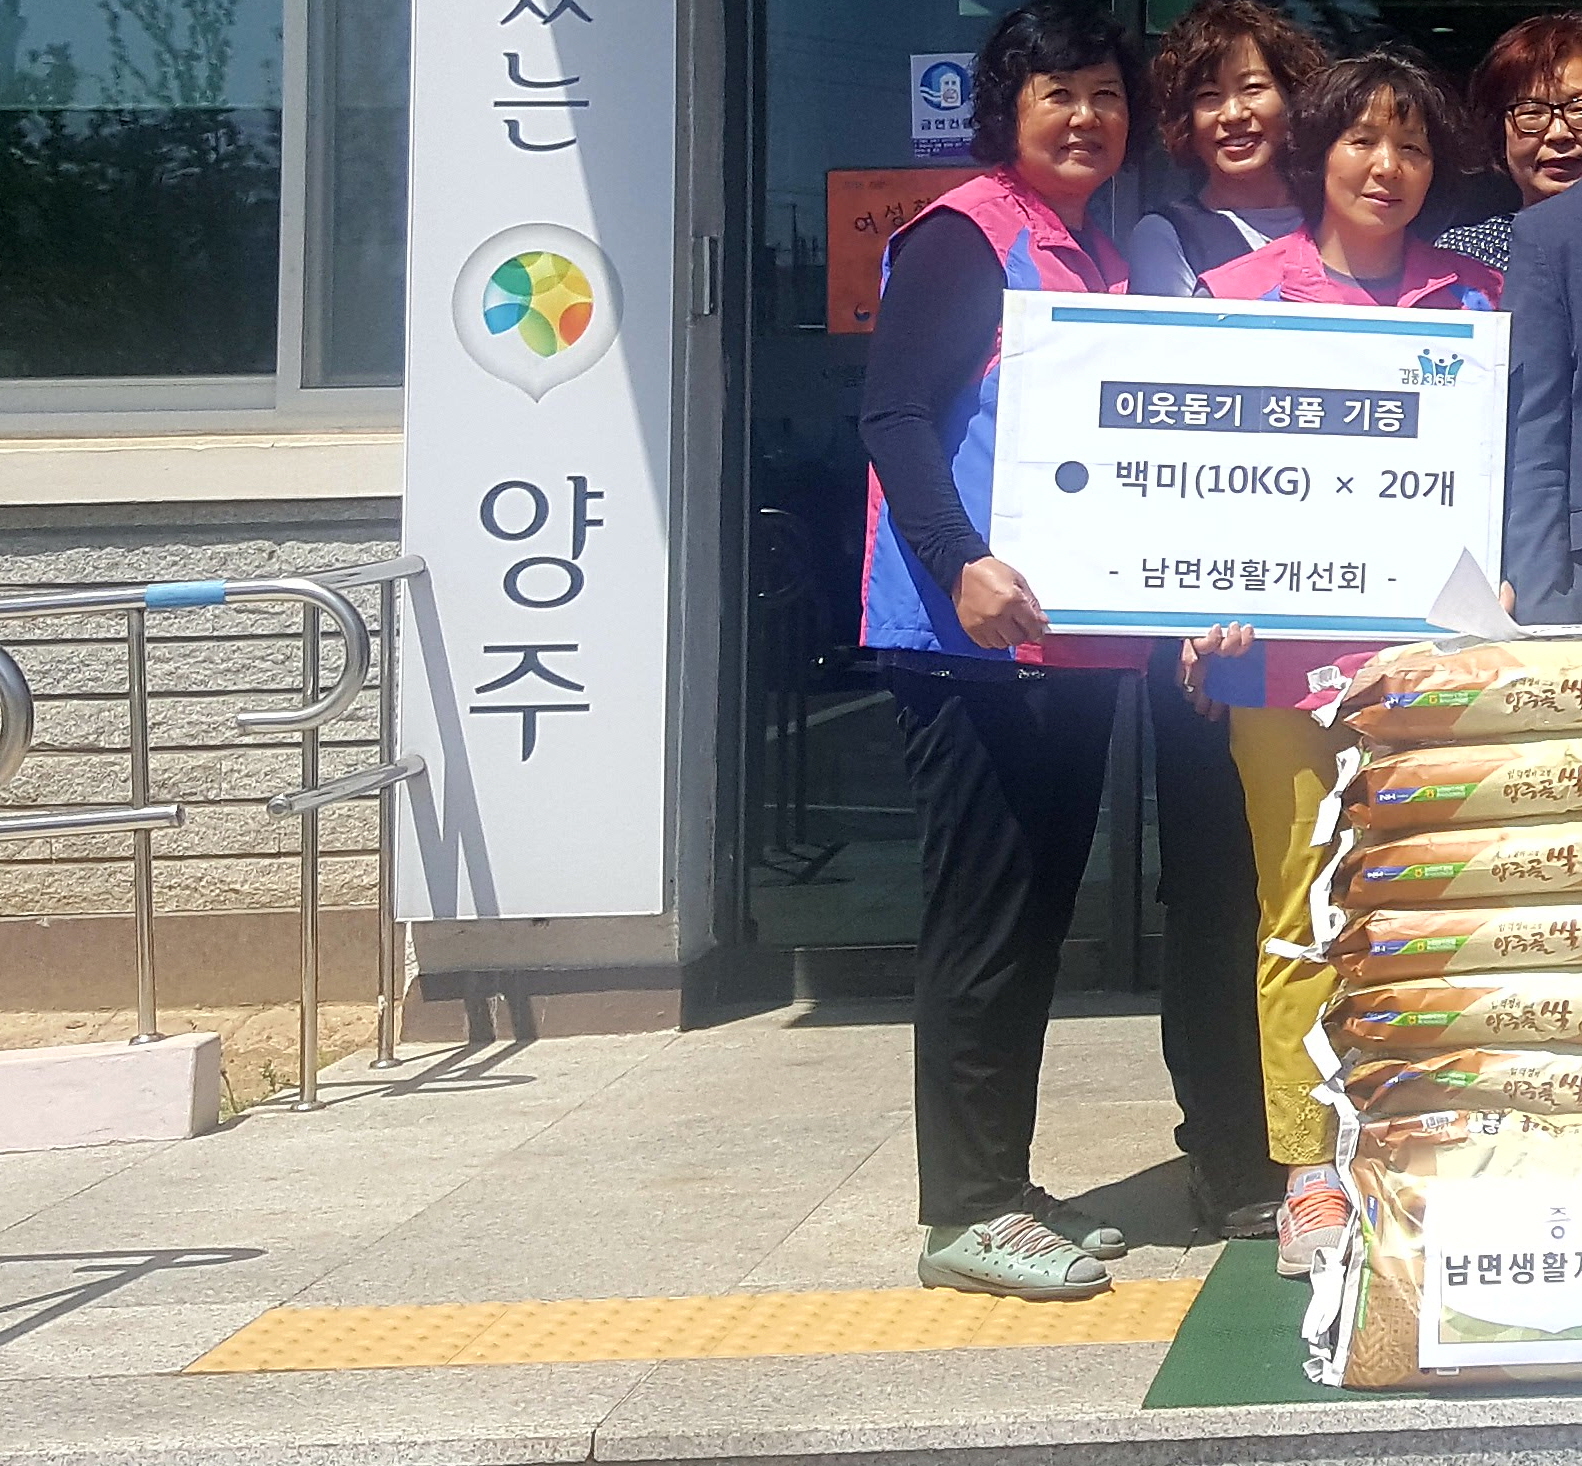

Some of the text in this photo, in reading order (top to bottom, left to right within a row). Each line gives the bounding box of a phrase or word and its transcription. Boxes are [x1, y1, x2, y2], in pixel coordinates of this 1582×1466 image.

[1115, 389, 1405, 432] 이웃돕기 성품 기증
[1115, 460, 1312, 501] 백미(10KG)
[1378, 469, 1456, 507] 20개
[1141, 557, 1367, 594] 남면생활개선회
[468, 474, 605, 763] 양주
